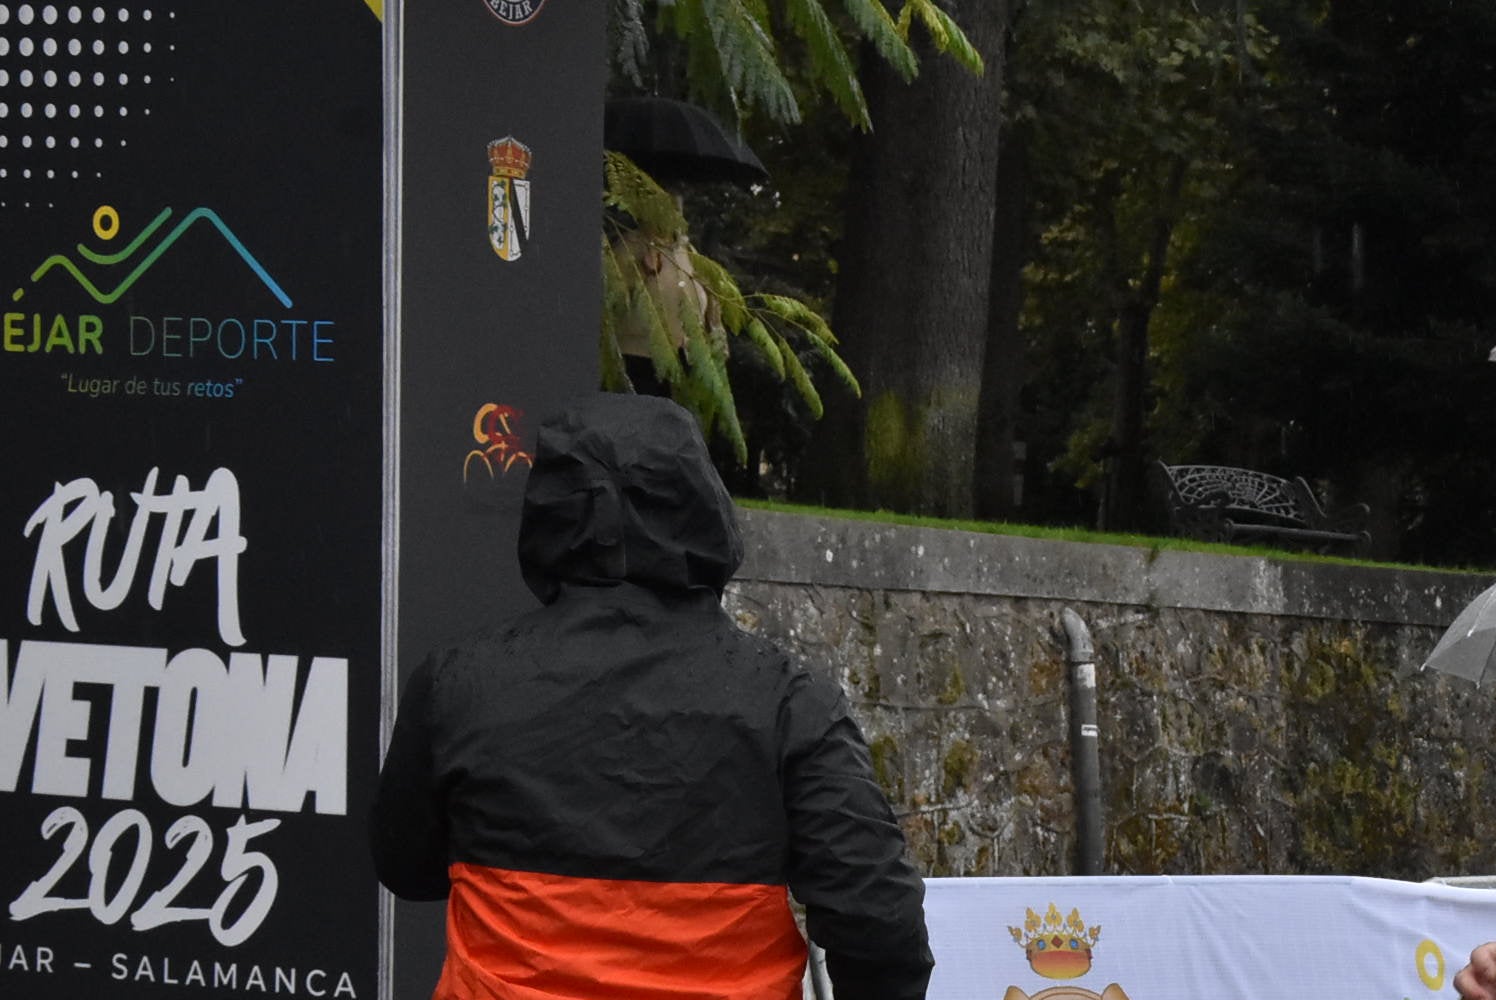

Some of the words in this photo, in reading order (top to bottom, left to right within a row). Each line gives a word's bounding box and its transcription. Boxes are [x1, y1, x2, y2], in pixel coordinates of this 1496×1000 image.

[129, 315, 335, 362] DEPORTE
[124, 376, 147, 395] de
[153, 381, 181, 397] tus
[24, 466, 248, 647] RUTA
[9, 806, 281, 947] 2025
[111, 952, 357, 1000] SALAMANCA
